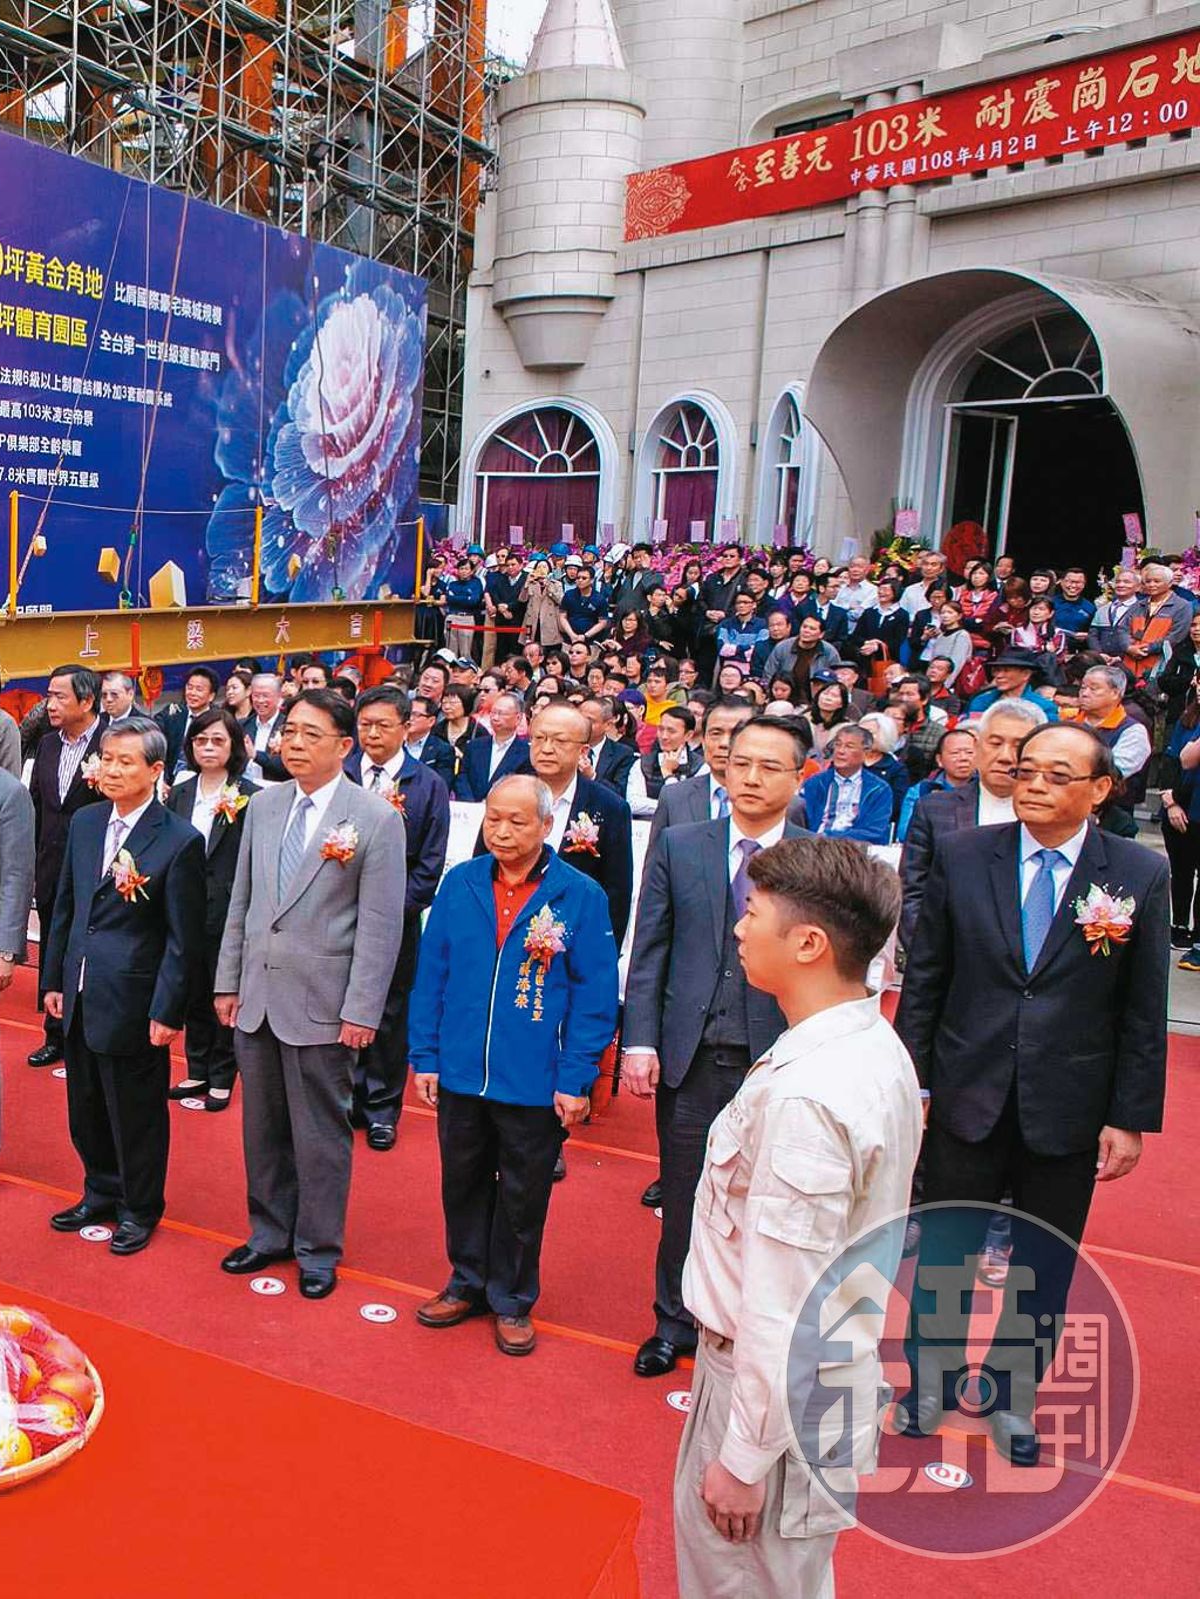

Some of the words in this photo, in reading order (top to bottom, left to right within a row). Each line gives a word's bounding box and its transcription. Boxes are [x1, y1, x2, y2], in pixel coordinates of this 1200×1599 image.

[849, 106, 948, 162] 103米
[850, 133, 1037, 186] 中華民國108年4月2日
